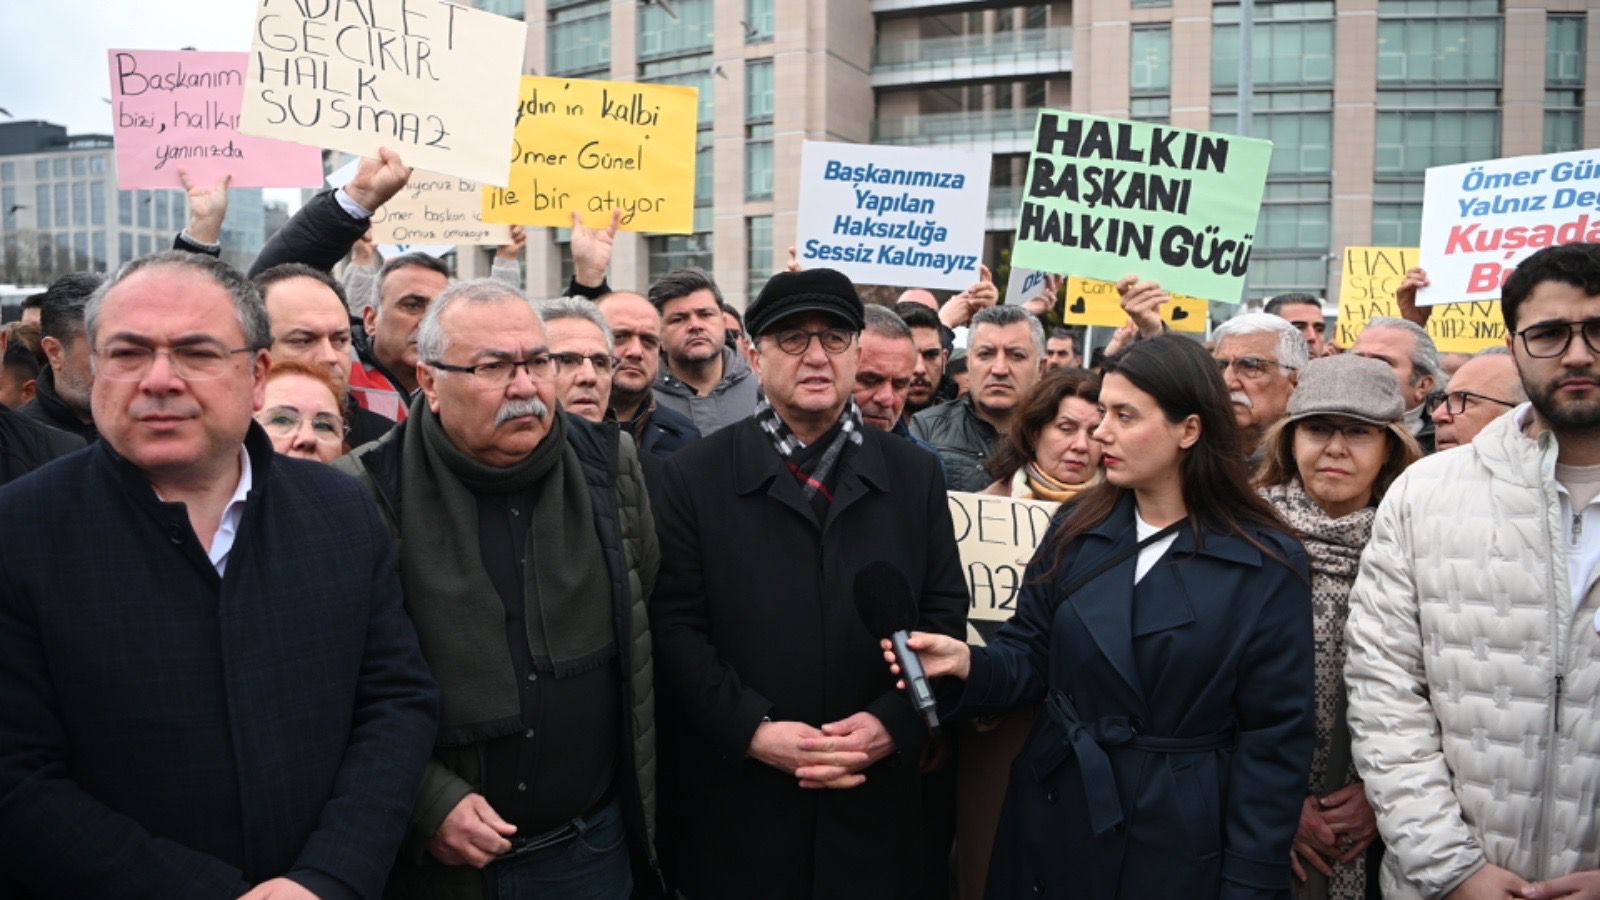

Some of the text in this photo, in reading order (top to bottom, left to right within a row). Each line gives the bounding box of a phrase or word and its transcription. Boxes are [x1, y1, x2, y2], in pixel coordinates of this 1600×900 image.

[116, 53, 242, 96] Başkanım
[257, 51, 382, 102] HALK
[119, 101, 166, 134] bizi,
[261, 90, 452, 150] SUSMAZ
[601, 89, 660, 126] kalbi
[154, 140, 244, 170] yanınızda
[577, 141, 642, 170] Günel
[1036, 113, 1230, 173] HALKIN
[824, 160, 965, 189] Başkanımıza
[1029, 158, 1192, 215] BAŞKANI
[1462, 166, 1547, 191] Ömer
[534, 179, 570, 211] bir
[587, 191, 666, 225] atıyor
[855, 188, 935, 216] Yapılan
[1458, 194, 1547, 218] Yalnız
[833, 214, 948, 246] Haksızlığa
[1018, 201, 1253, 277] HALKIN GÜCÜ
[804, 239, 978, 274] Sessiz Kalmayız
